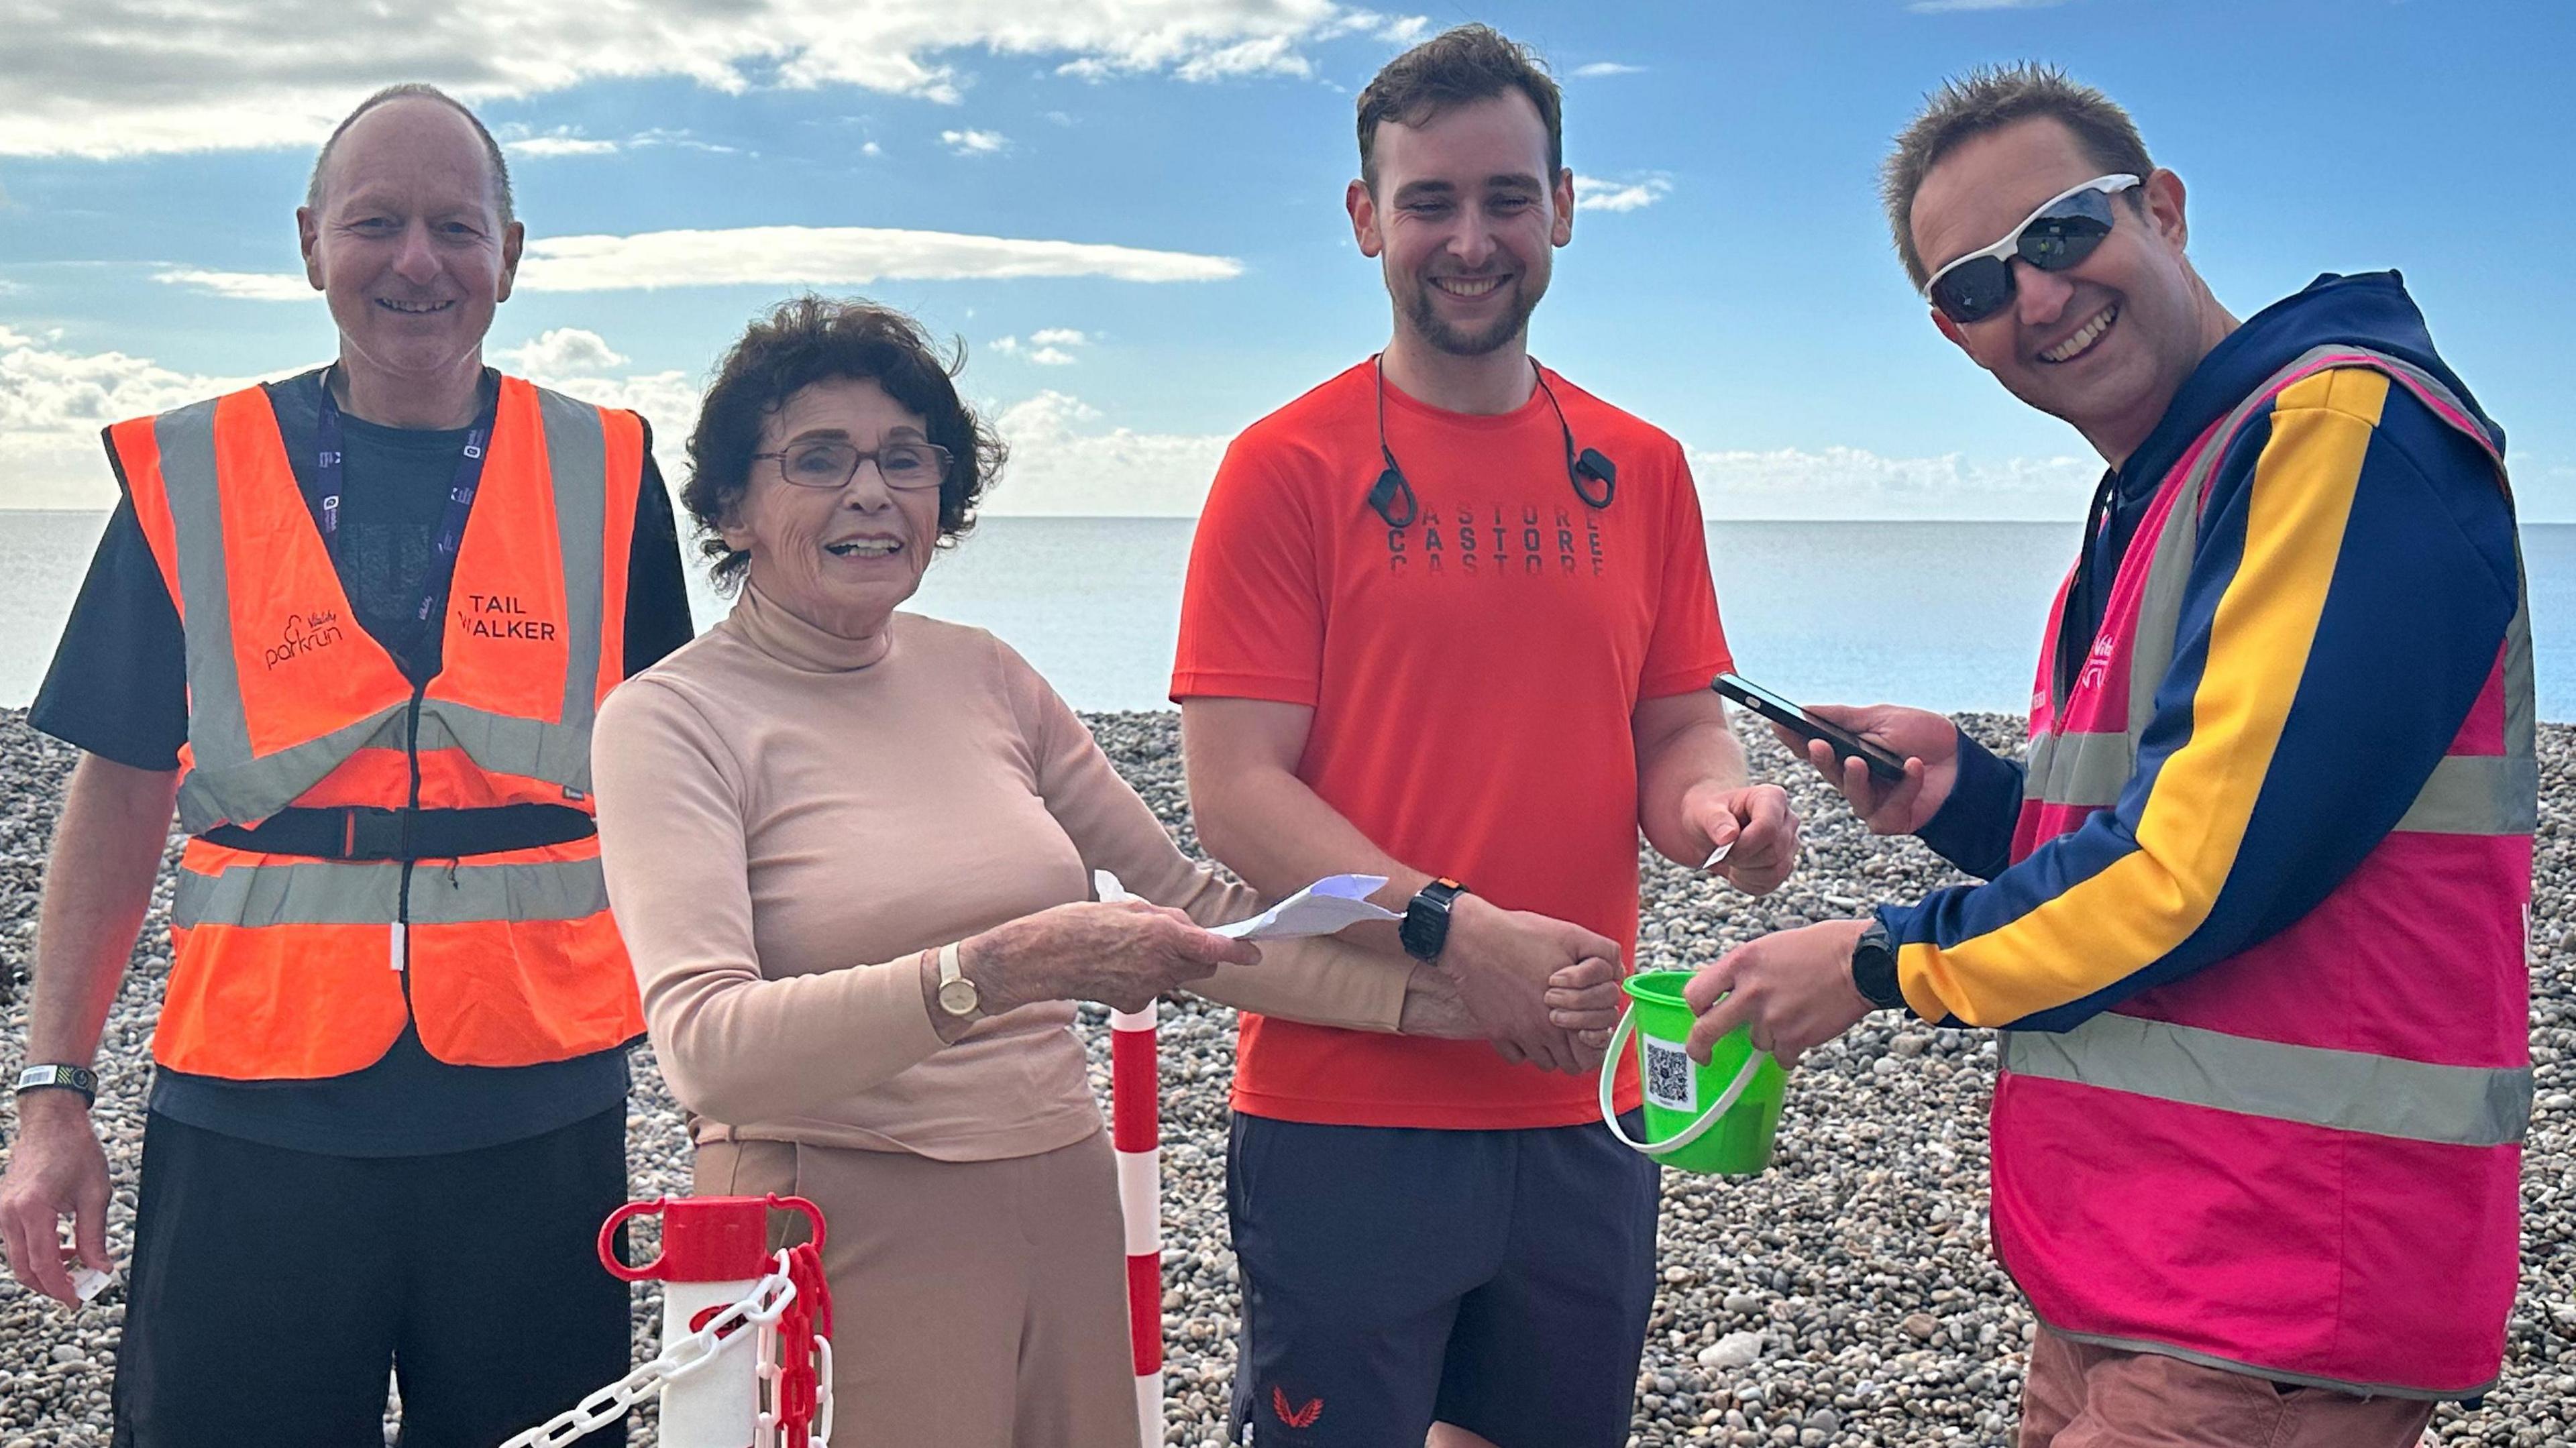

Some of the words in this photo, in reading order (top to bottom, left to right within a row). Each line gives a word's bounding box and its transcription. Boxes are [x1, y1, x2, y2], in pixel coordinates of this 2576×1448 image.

[1421, 504, 1600, 531] ASTORE
[1388, 526, 1603, 556] CASTORE
[469, 595, 527, 614] TAIL
[265, 626, 343, 671] parkrun
